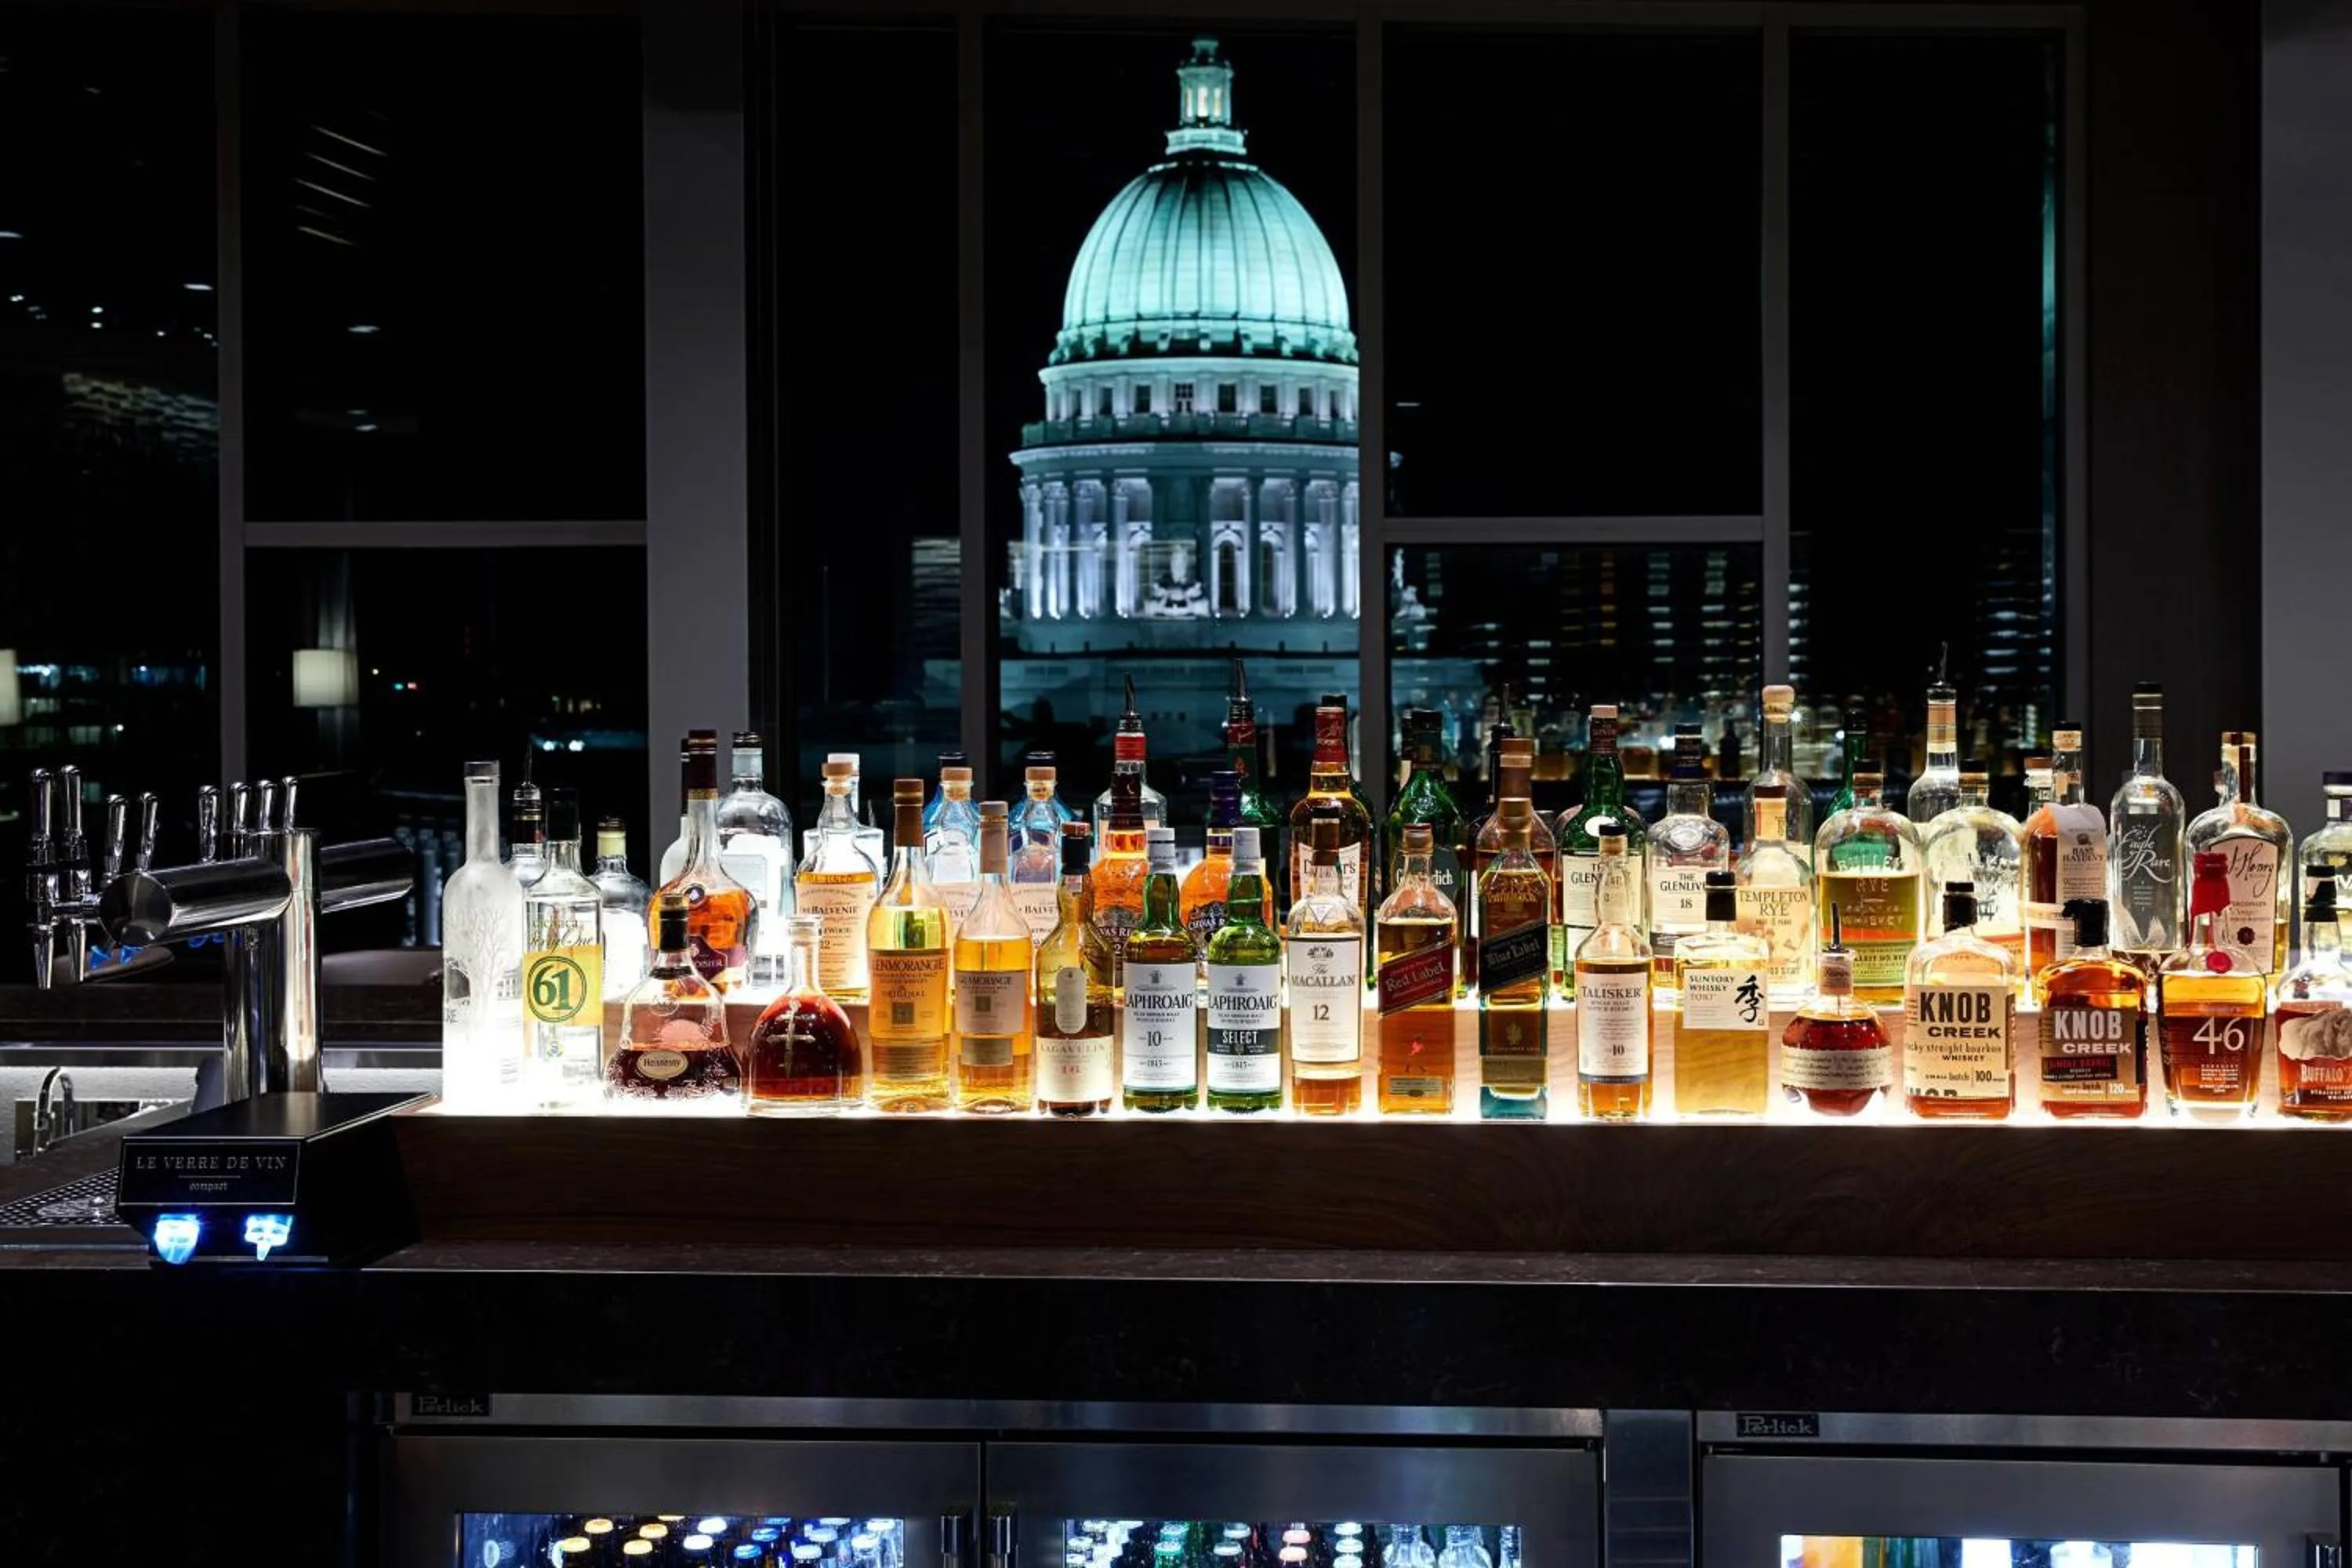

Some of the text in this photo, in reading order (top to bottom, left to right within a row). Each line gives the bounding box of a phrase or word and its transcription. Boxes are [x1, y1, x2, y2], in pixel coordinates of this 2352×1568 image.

[1660, 881, 1706, 891] GLENLIV
[1739, 891, 1807, 902] TEMPLETON
[1760, 903, 1788, 916] RYE
[1484, 947, 1512, 967] Blue
[1511, 938, 1541, 958] Label
[1292, 975, 1356, 988] MACALLAN
[1386, 973, 1411, 992] Red
[1412, 961, 1449, 982] Label
[1690, 975, 1734, 984] SUNTORY
[533, 964, 573, 1011] 61
[1581, 985, 1642, 999] TALISKER
[1208, 995, 1278, 1011] LAPHROAIG
[1920, 992, 1991, 1023] KNOB
[1312, 1004, 1330, 1021] 12
[1928, 1026, 2002, 1039] CREEK
[2054, 1011, 2123, 1040] KNOB
[1147, 1031, 1162, 1047] 10
[1222, 1031, 1258, 1044] SELECT
[2192, 1016, 2245, 1054] 46
[1612, 1044, 1625, 1056] 10
[2062, 1044, 2132, 1054] CREEK
[1976, 1070, 1992, 1082] 100
[2300, 1064, 2343, 1083] BUFFALO
[2108, 1083, 2125, 1094] 120
[136, 1156, 288, 1170] LE VERRE DE VIN
[1742, 1416, 1817, 1434] Perlick
